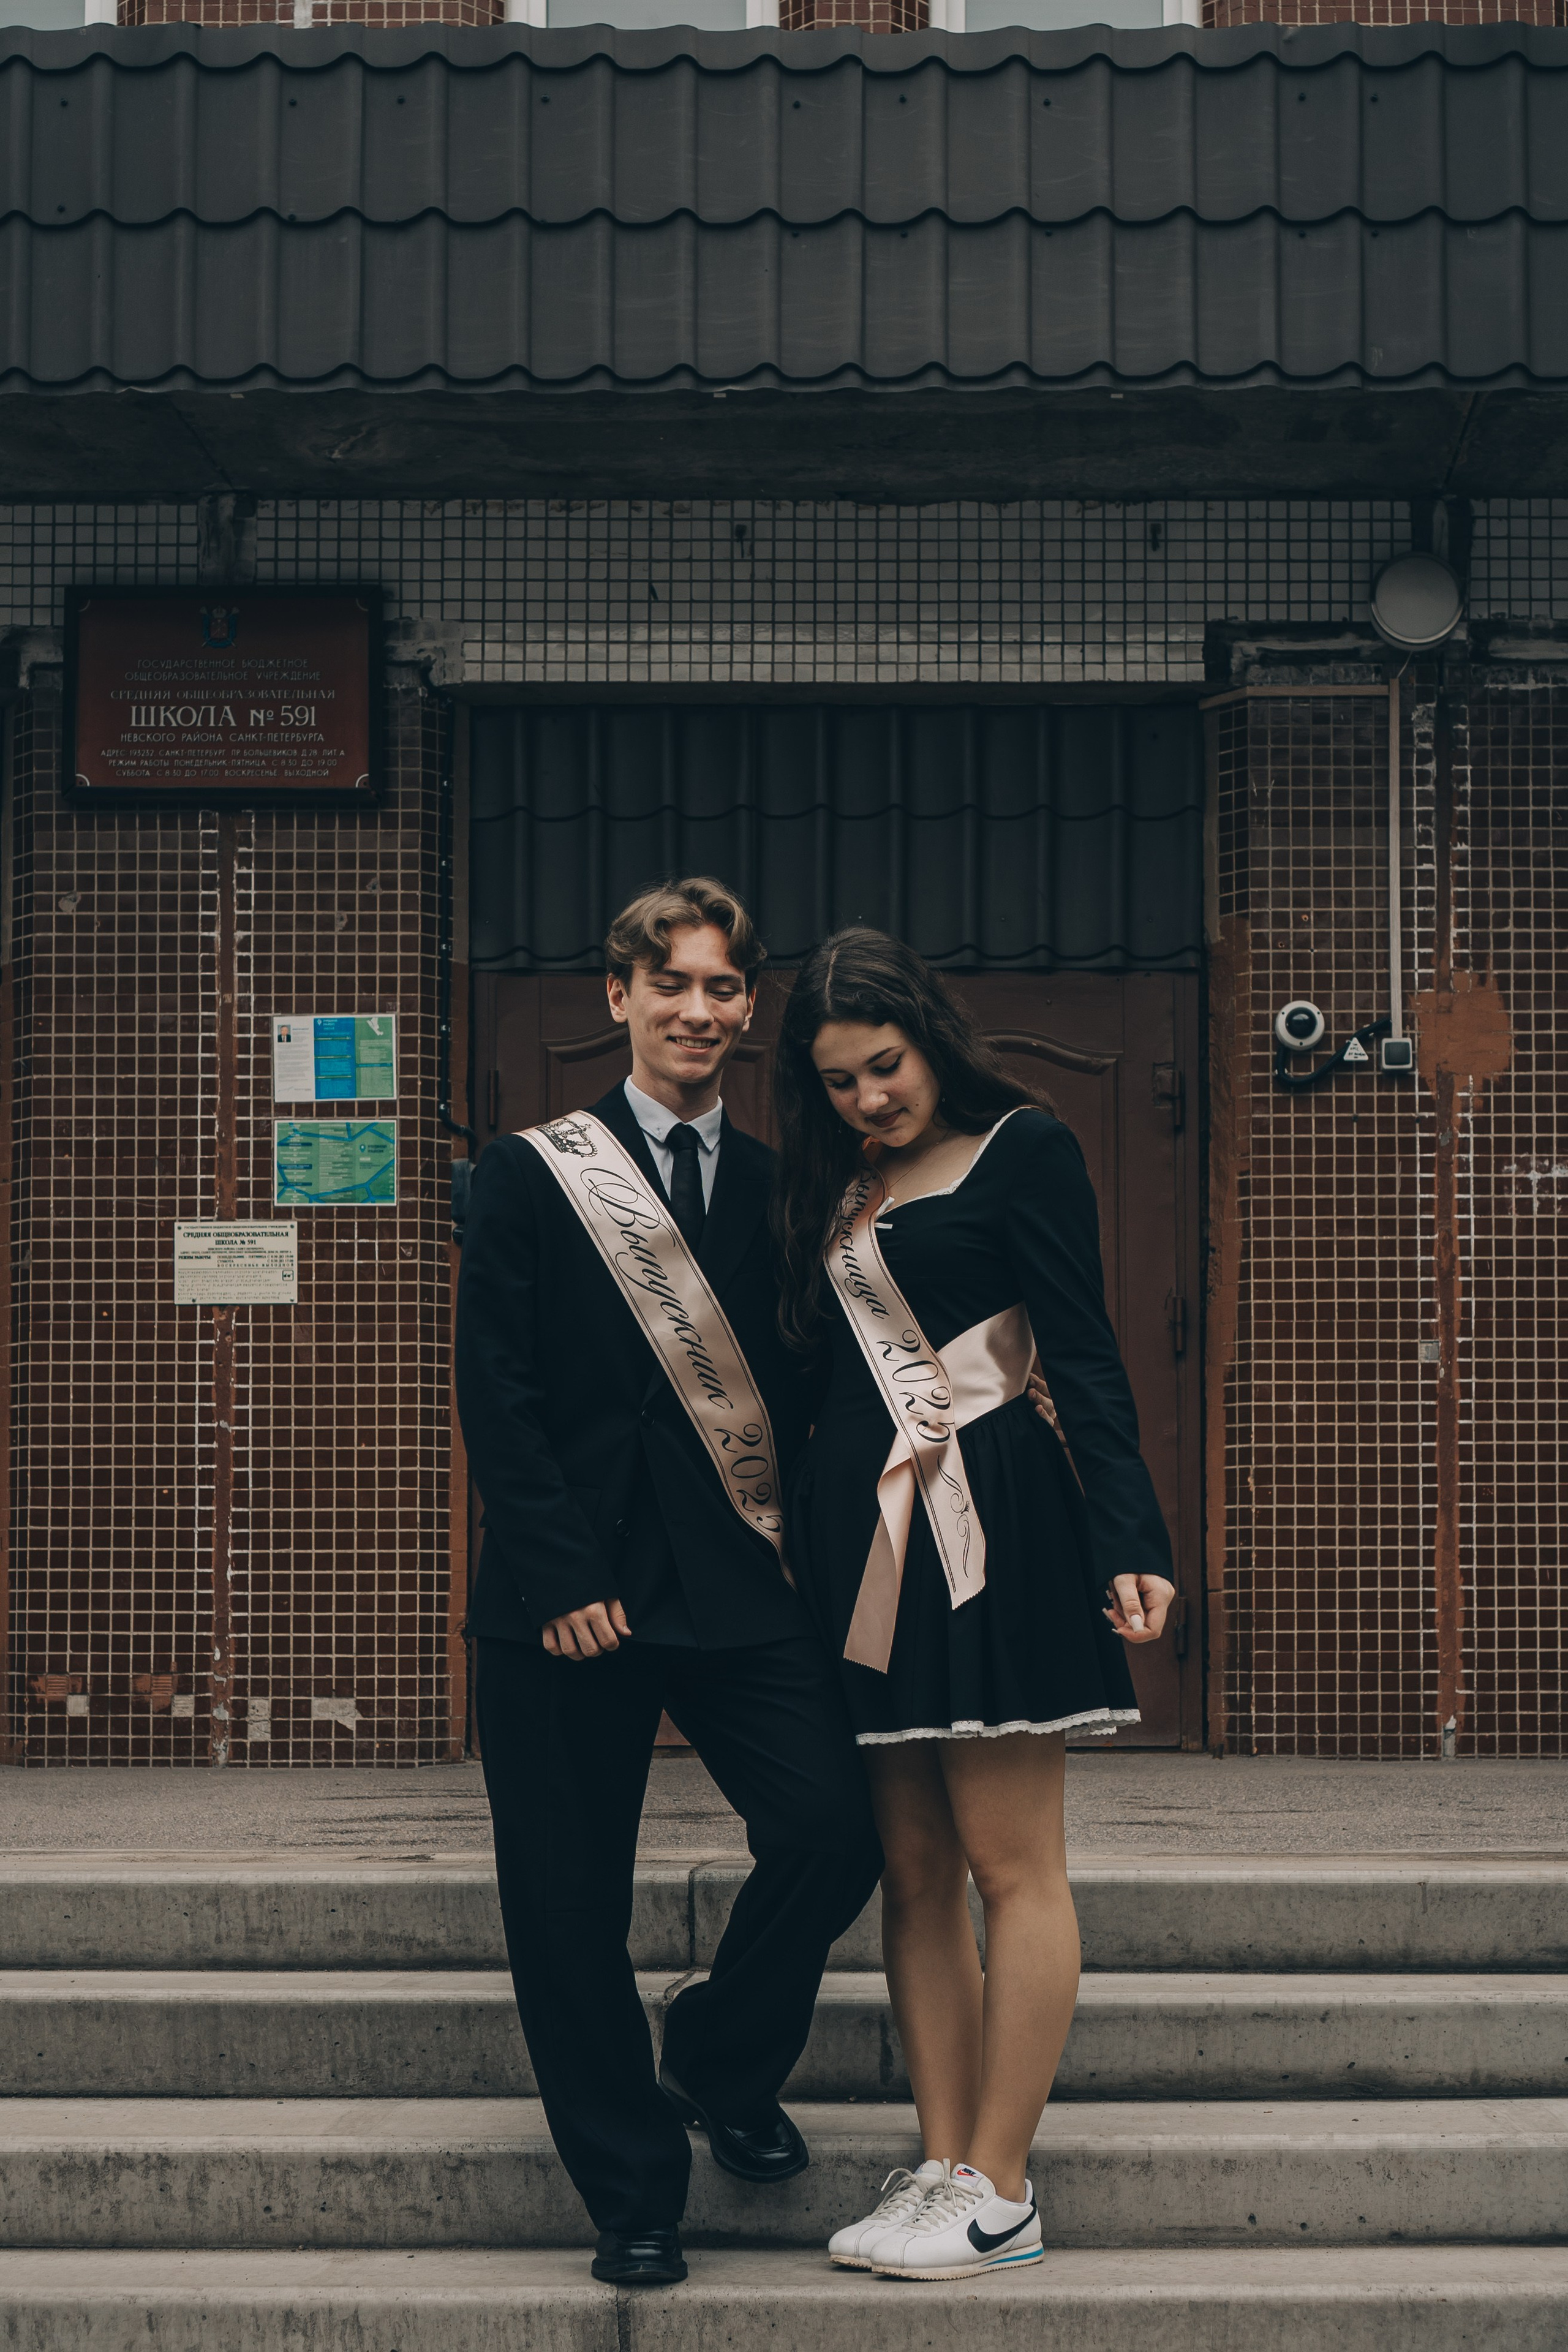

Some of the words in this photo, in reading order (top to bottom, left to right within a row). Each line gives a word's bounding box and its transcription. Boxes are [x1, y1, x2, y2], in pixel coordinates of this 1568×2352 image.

[138, 659, 235, 668] ГОСУДАРСТВЕННОЕ
[242, 659, 309, 668] БЮДЖЕТНОЕ
[125, 671, 249, 681] ОБЩЕОБРАЗОВАТЕЛЬНОЕ
[256, 671, 321, 680] УЧРЕЖДЕНИЕ
[110, 690, 171, 699] СРЕДНЯЯ
[176, 690, 335, 699] ОБЩЕОБРАЗОВАТЕЛЬНАЯ
[130, 706, 237, 727] ШКОЛА
[280, 705, 316, 726] 591
[121, 733, 176, 742] НЕВСКОГО
[181, 731, 223, 742] РАЙОНА
[229, 733, 325, 742] САНКТ-ПЕТЕРБУРГА
[580, 1167, 734, 1410] Выпускник
[714, 1423, 784, 1533] 2025
[876, 1329, 954, 1443] 2025
